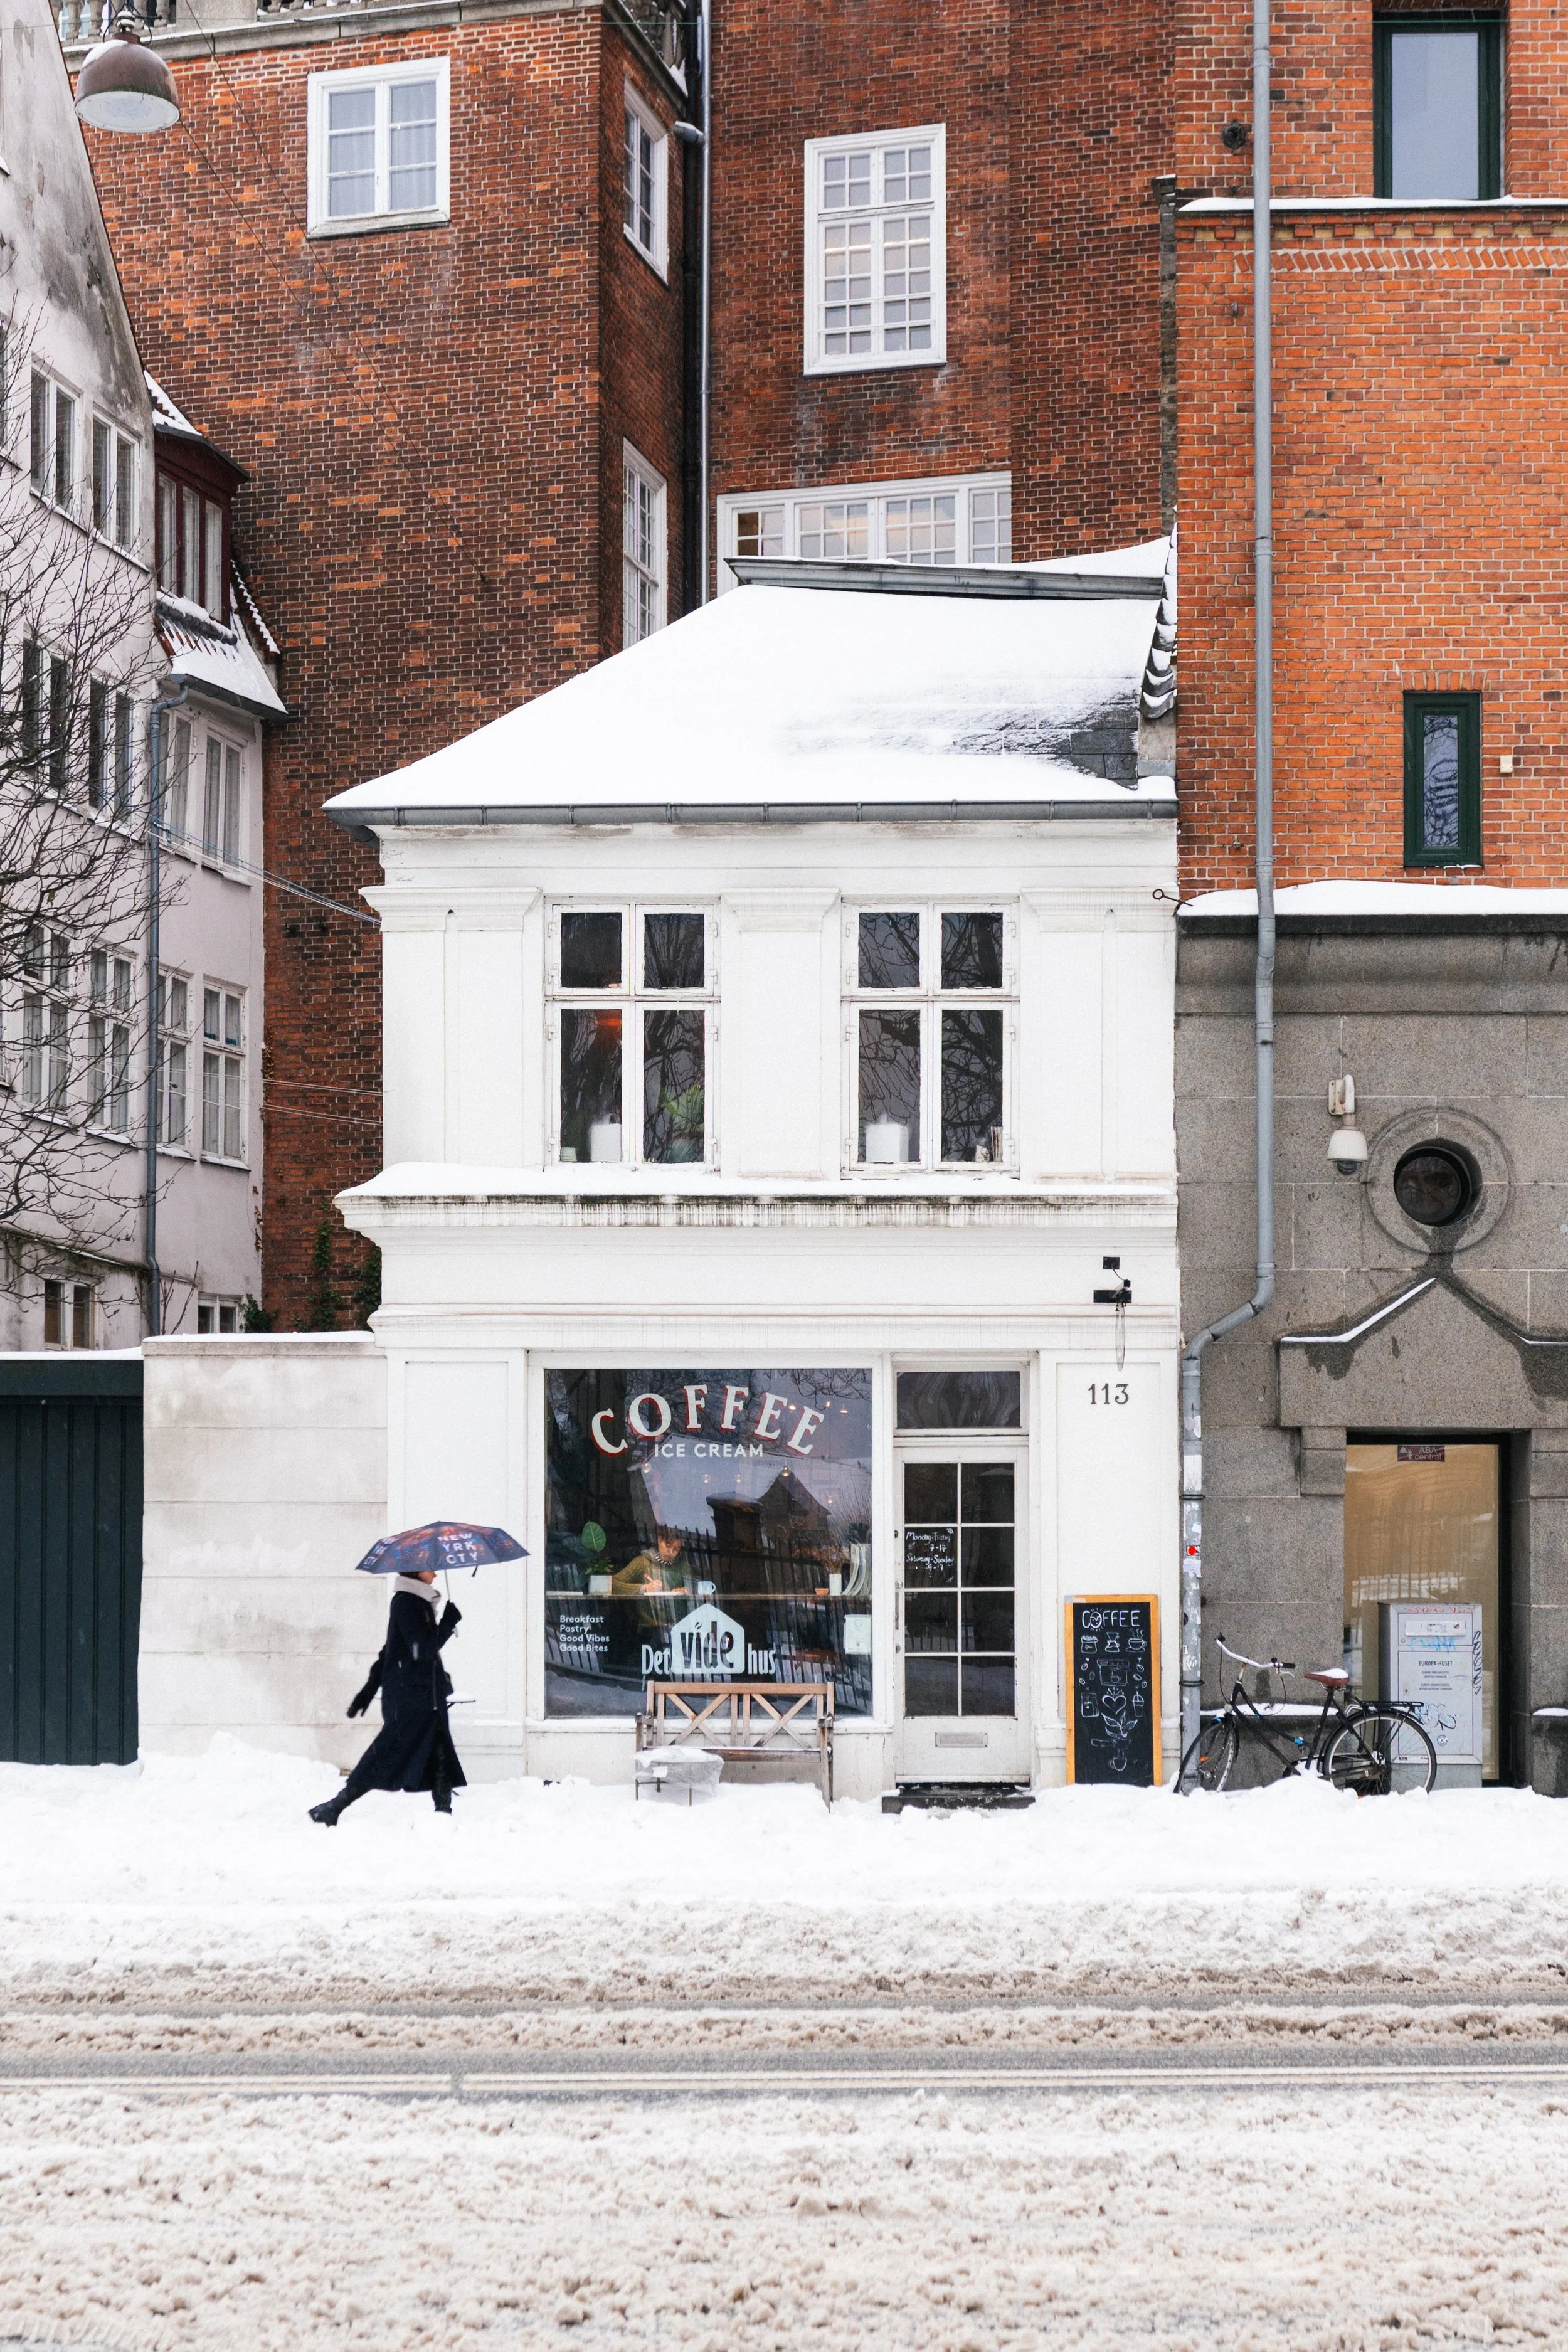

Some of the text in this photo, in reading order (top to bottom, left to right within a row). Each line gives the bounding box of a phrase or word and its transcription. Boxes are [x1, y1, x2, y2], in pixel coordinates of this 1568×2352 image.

[1088, 1383, 1129, 1404] 113
[591, 1384, 824, 1458] COFFEE
[655, 1444, 763, 1458] ICE CREAM
[560, 1615, 603, 1623] Breakfast
[1082, 1609, 1141, 1629] COFFEE
[560, 1624, 589, 1634] Pastry
[559, 1644, 608, 1652] Good Bites
[642, 1621, 776, 1675] Det vide hus
